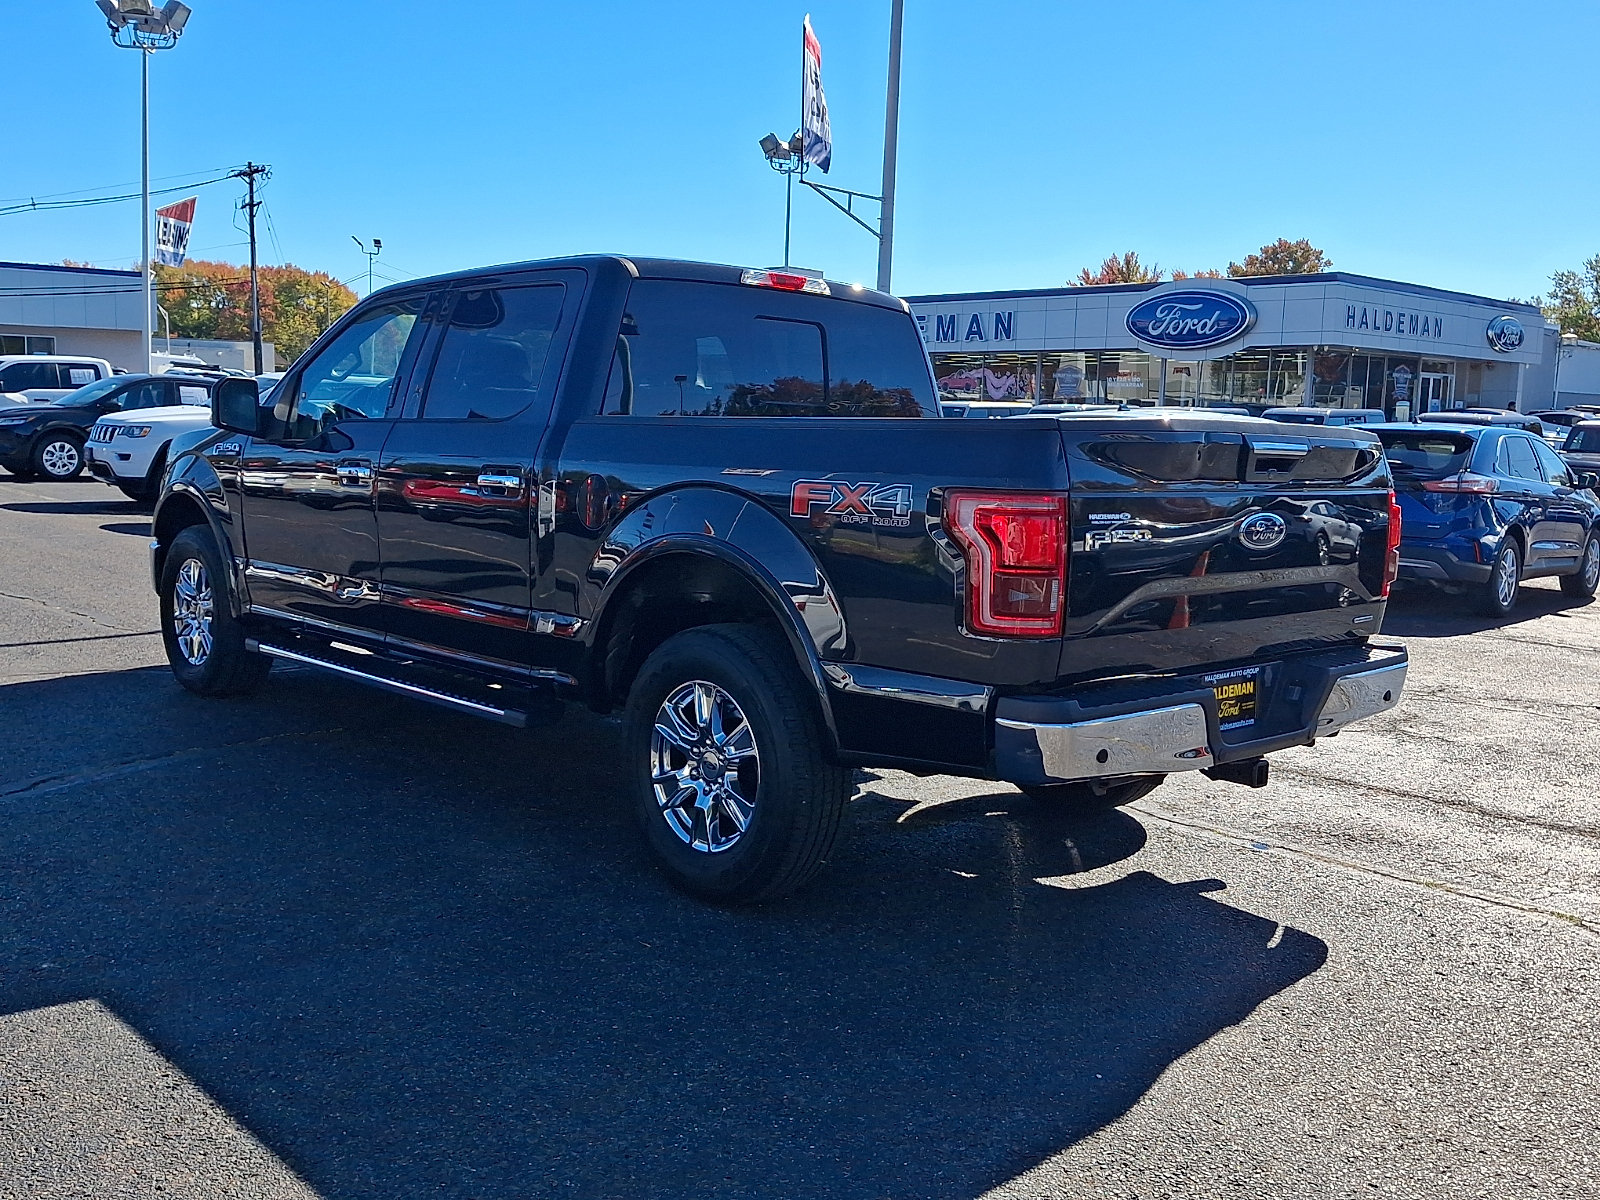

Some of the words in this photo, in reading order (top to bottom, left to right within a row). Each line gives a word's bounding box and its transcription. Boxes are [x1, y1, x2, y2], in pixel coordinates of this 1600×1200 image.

[1148, 303, 1221, 337] Ford
[1346, 304, 1443, 339] HALDEMAN
[1501, 324, 1521, 345] Ford
[790, 479, 912, 518] FX4
[841, 515, 869, 524] OFF
[872, 517, 911, 527] ROAD
[1252, 520, 1278, 541] Ford
[1204, 672, 1230, 682] HALDEMAN
[1230, 670, 1242, 678] AUTO
[1243, 667, 1260, 676] GROUP
[1218, 700, 1240, 718] Ford
